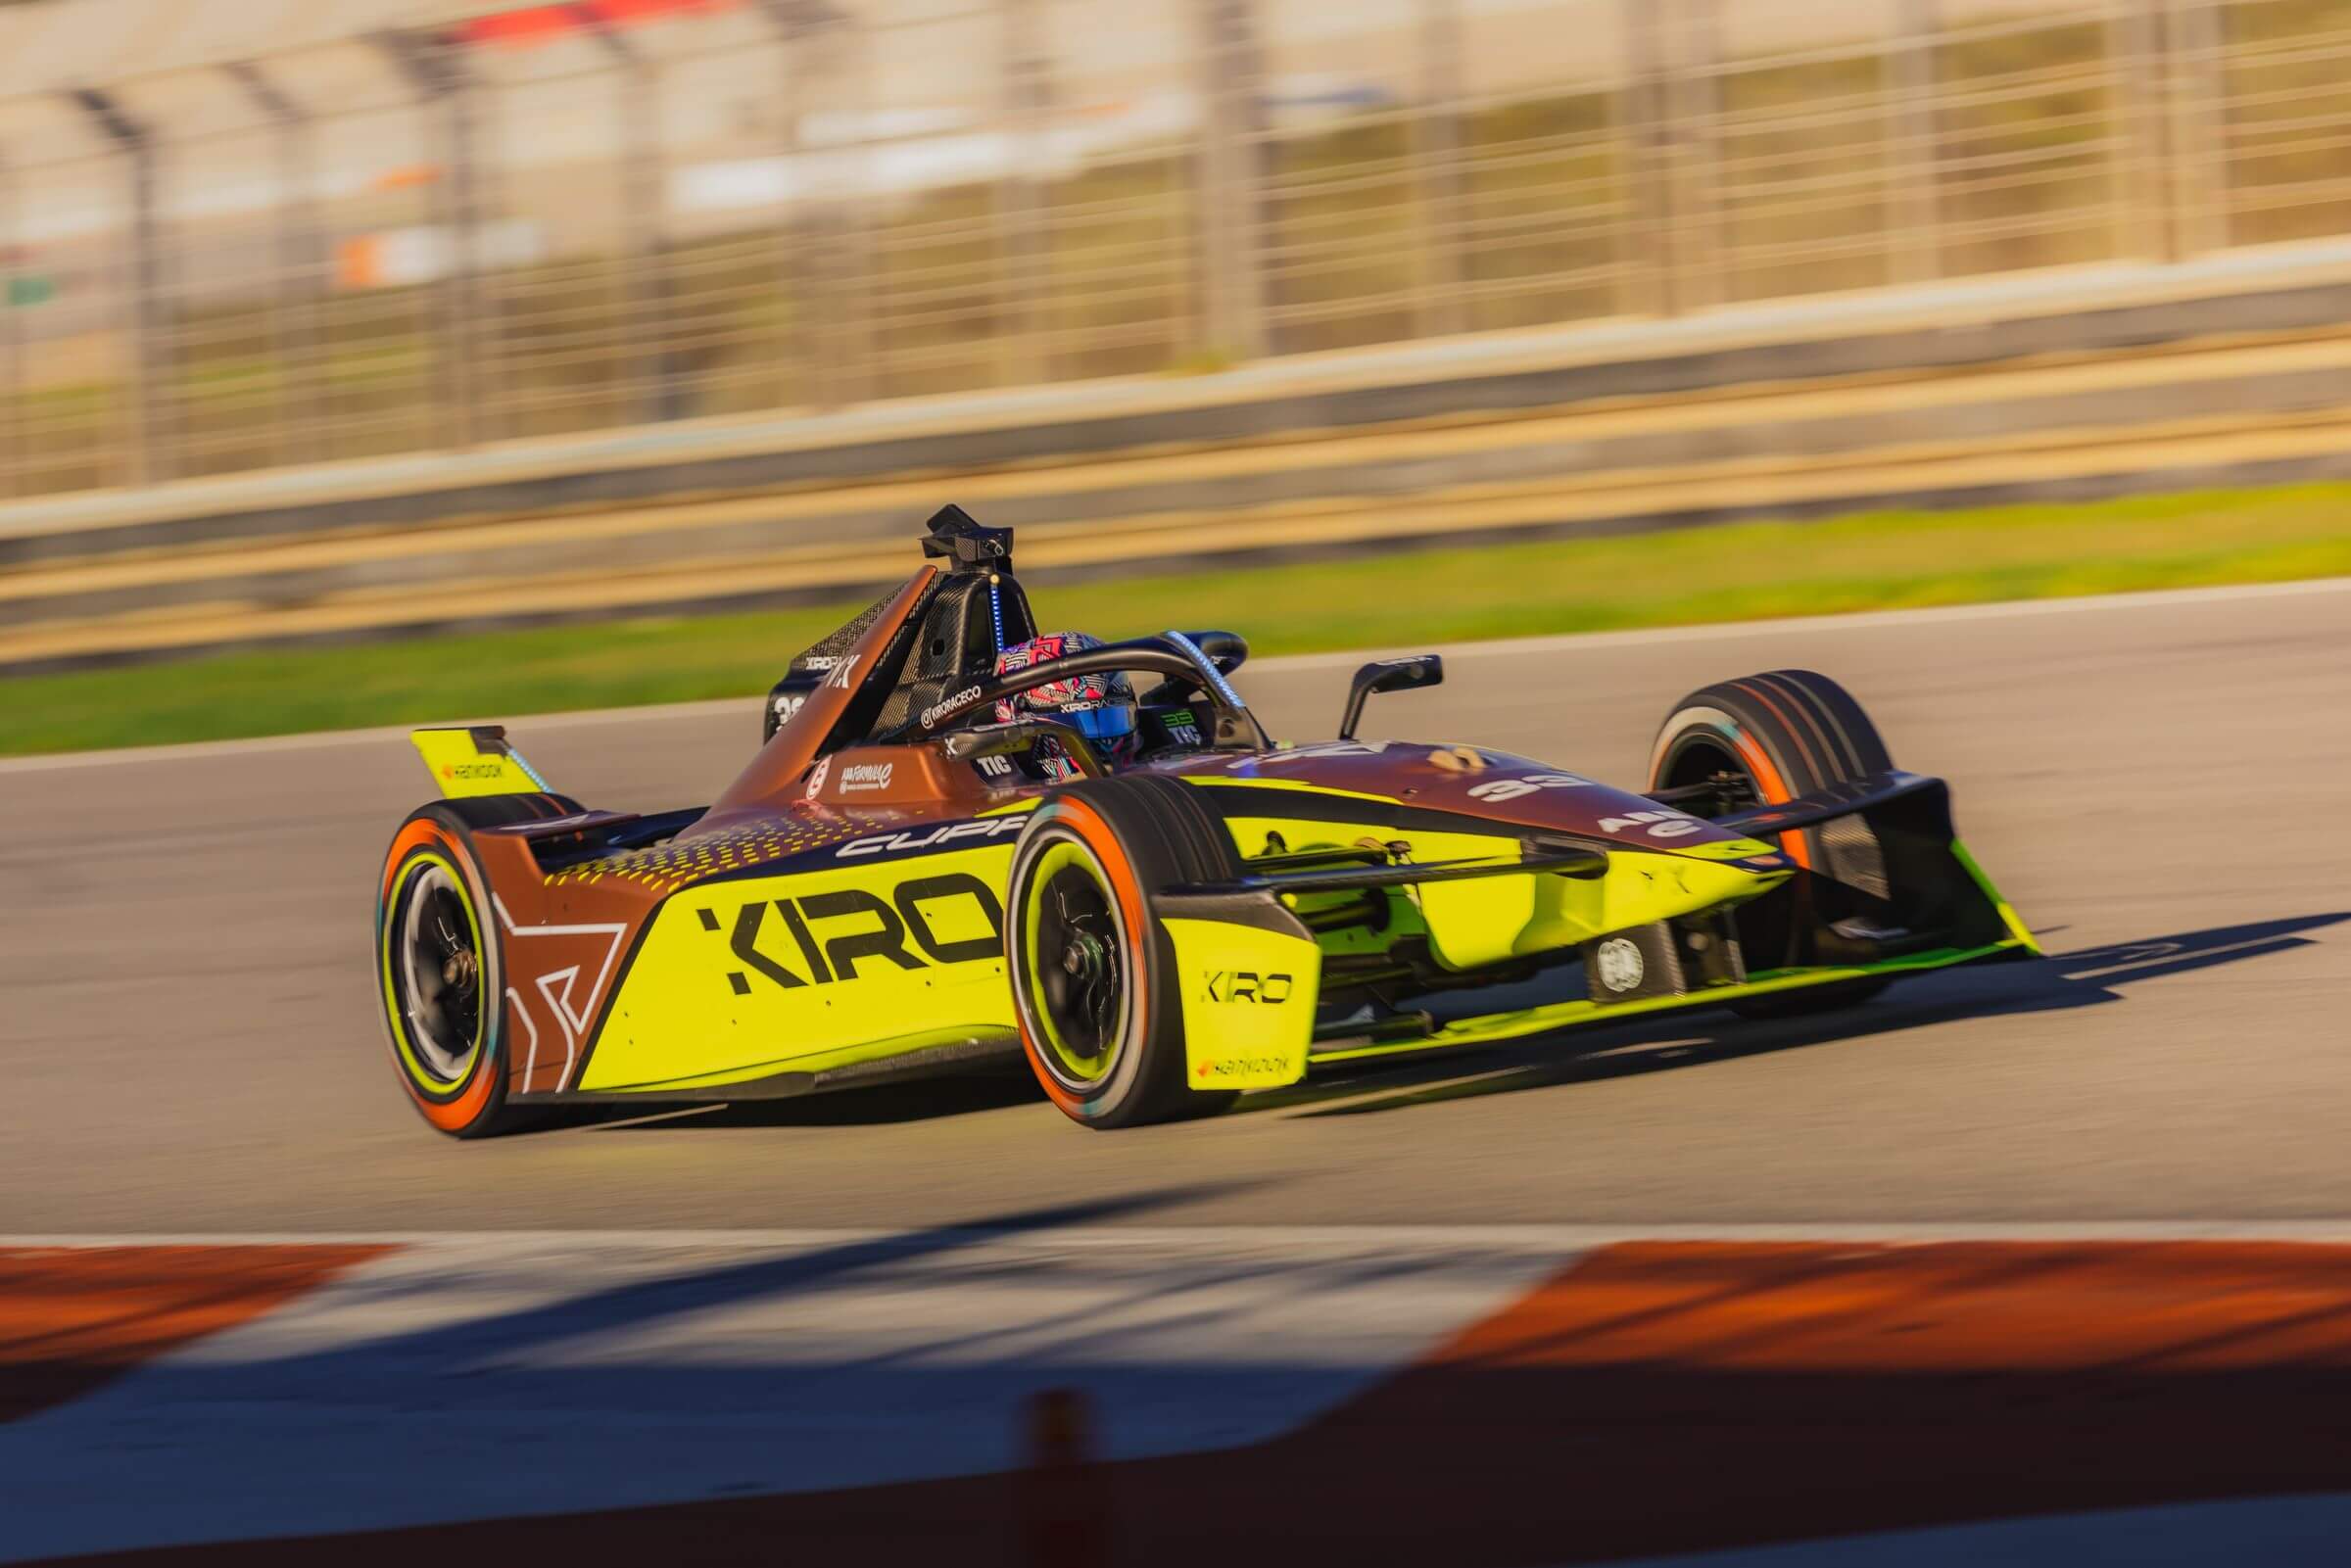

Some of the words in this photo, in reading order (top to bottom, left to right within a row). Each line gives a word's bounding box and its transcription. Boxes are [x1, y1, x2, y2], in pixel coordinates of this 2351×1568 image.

[774, 696, 807, 732] 3
[1160, 711, 1195, 727] 33
[1168, 725, 1201, 744] TIC
[977, 754, 1012, 777] TIC
[696, 873, 1007, 995] KIRO
[1200, 971, 1293, 1004] KIRO
